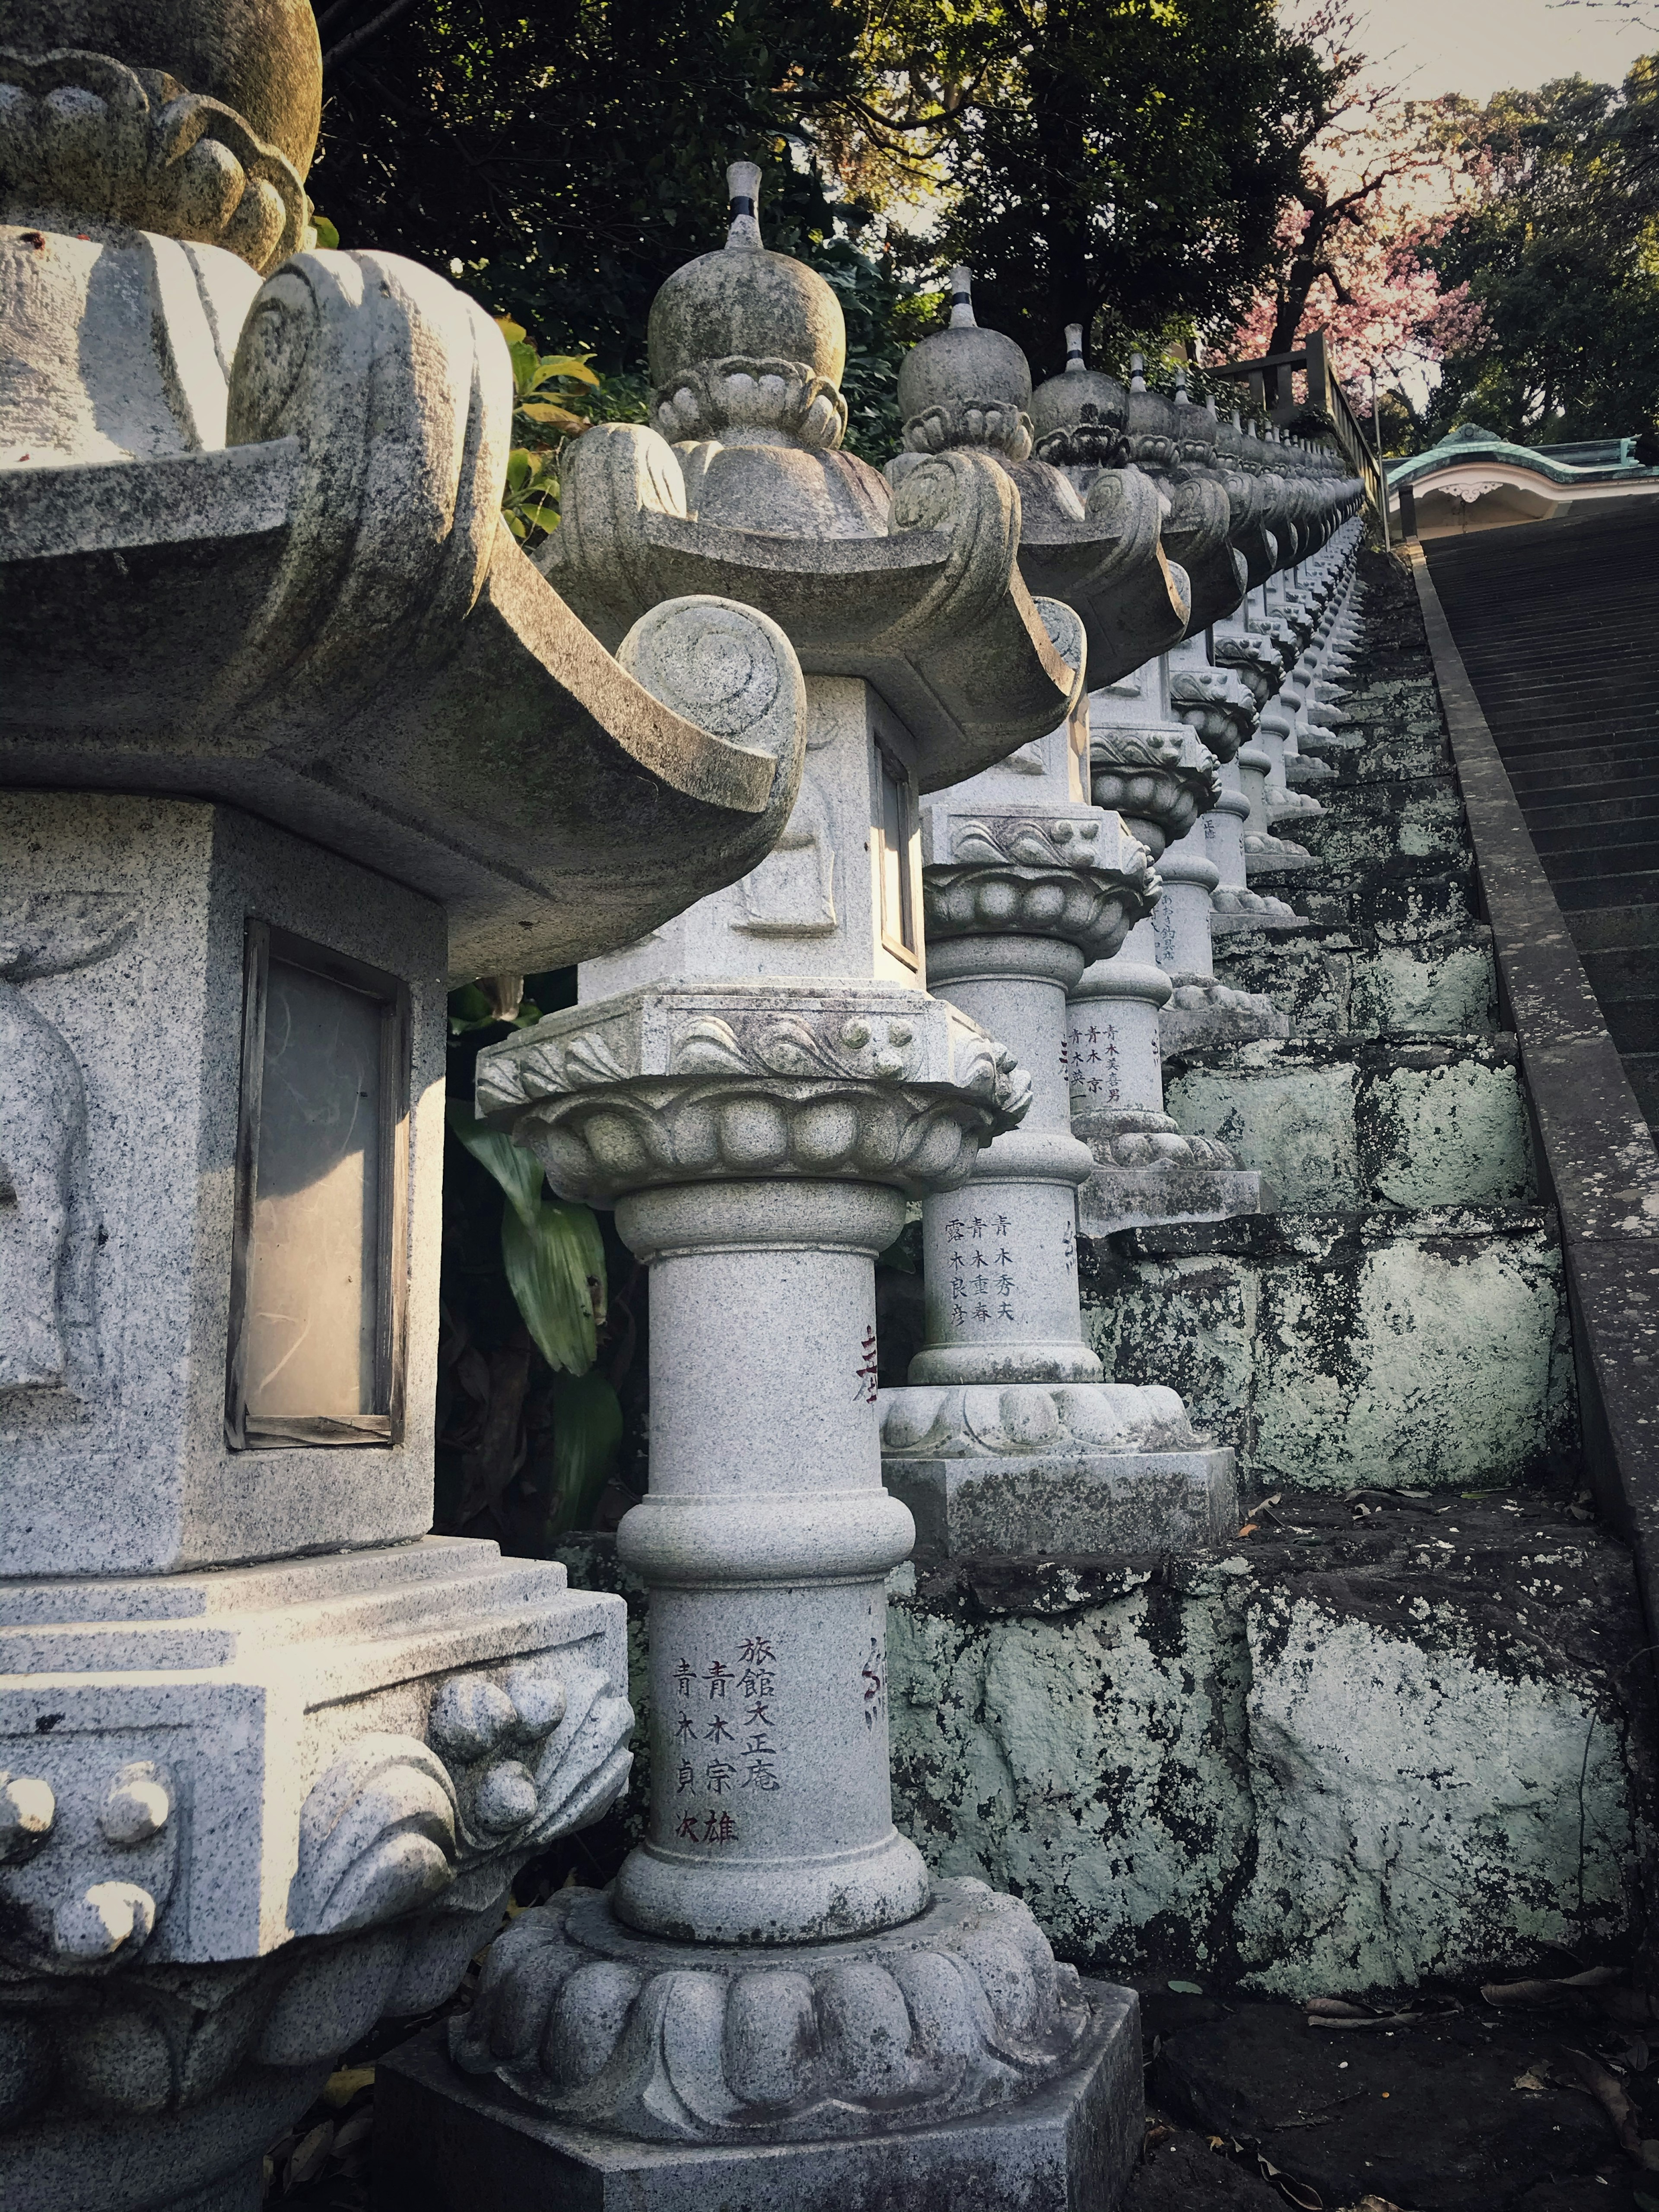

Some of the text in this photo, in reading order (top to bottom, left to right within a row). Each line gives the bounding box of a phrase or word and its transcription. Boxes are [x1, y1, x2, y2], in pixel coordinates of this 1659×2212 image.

[1068, 1029, 1086, 1099] 青木英一
[1085, 1026, 1103, 1093] 青木京
[1103, 1024, 1122, 1103] 青木美喜男
[945, 1219, 968, 1327] 露木良彦
[967, 1217, 992, 1323] 青木重春
[992, 1215, 1015, 1321] 青木秀夫
[673, 1658, 699, 1843] 青木貞次
[701, 1660, 738, 1845] 青木宗雄
[736, 1636, 780, 1792] 旅館大正庵
